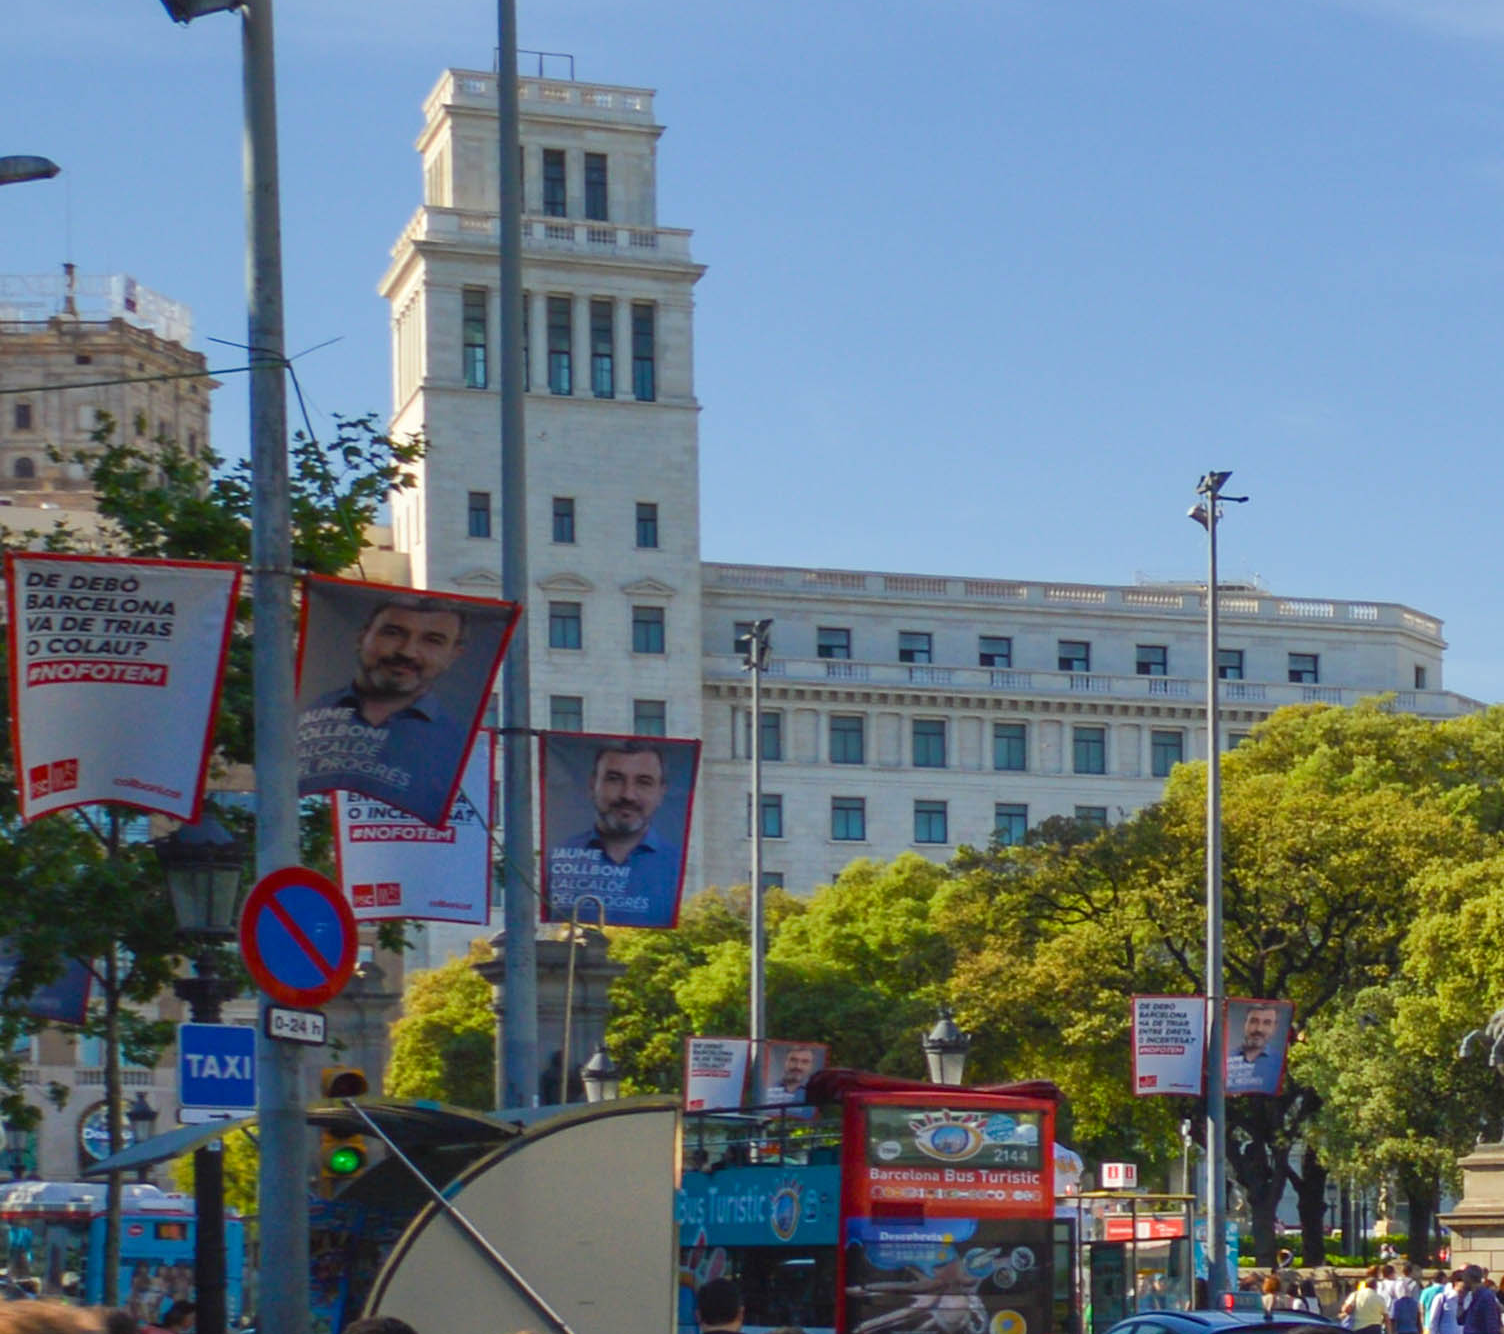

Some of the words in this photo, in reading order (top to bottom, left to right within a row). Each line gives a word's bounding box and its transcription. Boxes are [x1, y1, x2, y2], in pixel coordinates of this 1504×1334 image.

[26, 572, 61, 588] DE
[69, 575, 140, 593] DEBÒ
[26, 594, 175, 615] BARCELONA
[27, 617, 51, 632] VA
[60, 617, 96, 632] DE
[103, 619, 174, 636] TRIAS
[27, 640, 40, 655] O
[47, 638, 148, 655] COLAU?
[28, 663, 164, 683] #NOFOTEM
[349, 808, 361, 820] O
[352, 826, 454, 840] #NOFOTEM
[551, 848, 602, 860] JAUME
[551, 863, 632, 878] COLLBONI
[273, 1019, 308, 1034] 0-24
[312, 1021, 322, 1035] h
[185, 1053, 252, 1079] TAXI
[994, 1148, 1029, 1163] 2144
[870, 1167, 940, 1182] Barcelona
[944, 1169, 975, 1184] Bus
